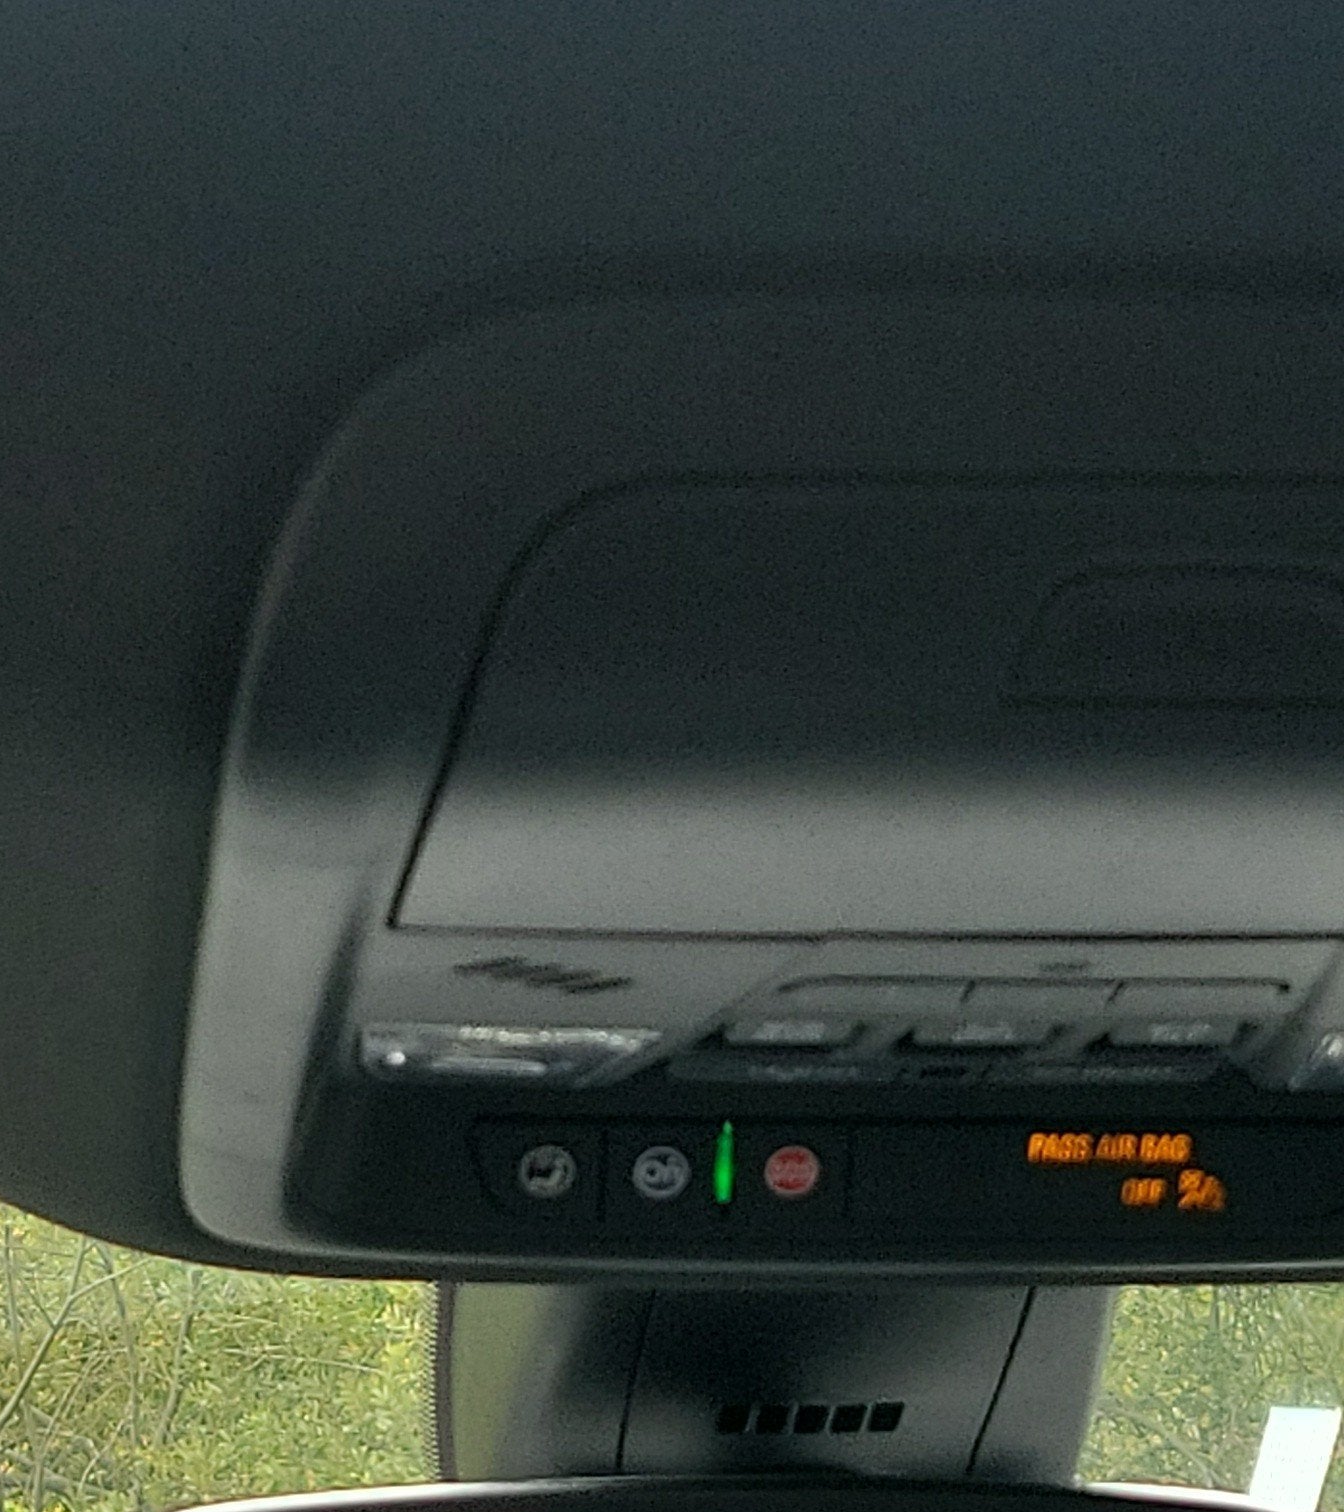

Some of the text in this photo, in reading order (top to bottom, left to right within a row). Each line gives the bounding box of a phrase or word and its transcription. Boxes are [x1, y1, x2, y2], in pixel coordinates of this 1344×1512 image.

[1027, 1132, 1192, 1162] PASS AIR BAG
[1120, 1178, 1166, 1205] OFF
